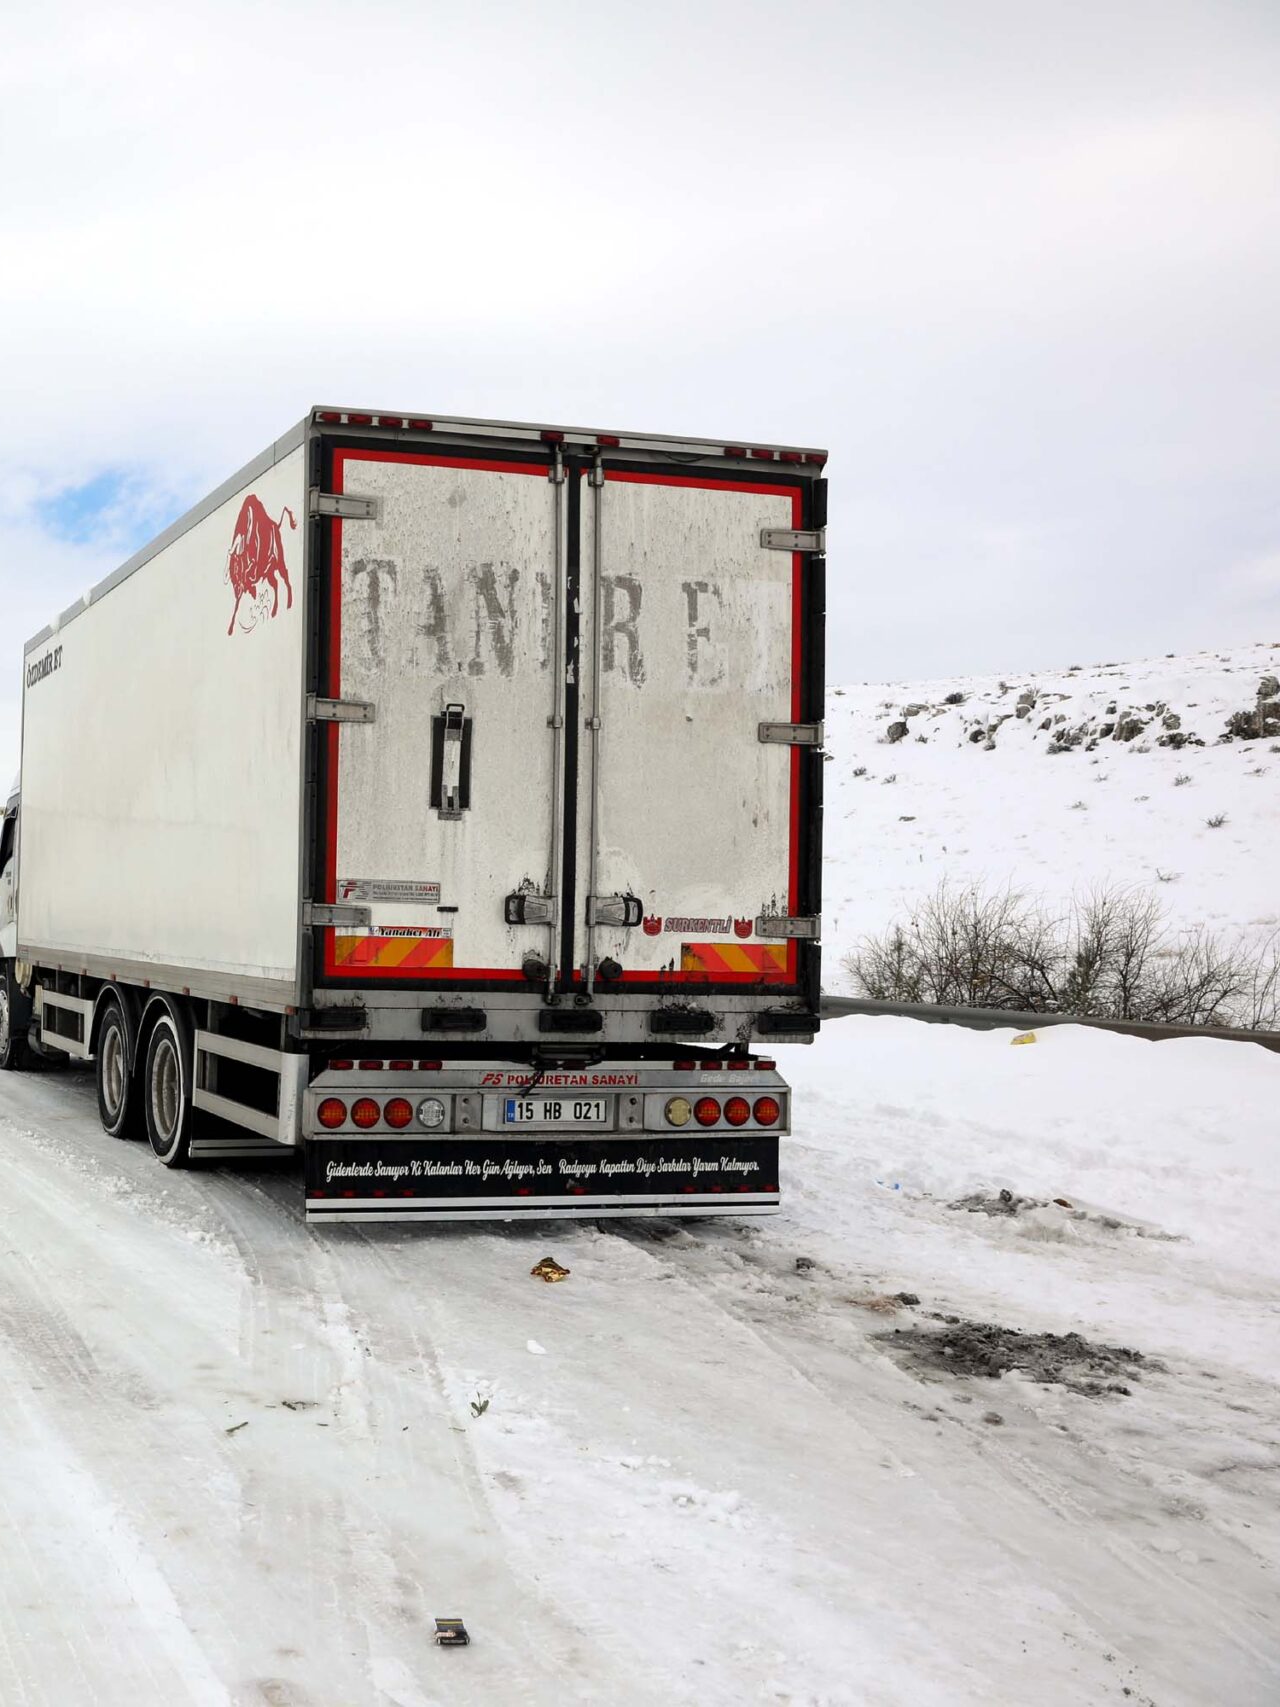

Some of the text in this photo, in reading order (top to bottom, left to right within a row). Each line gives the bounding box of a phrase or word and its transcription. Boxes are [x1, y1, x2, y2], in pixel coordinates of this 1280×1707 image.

[479, 1072, 504, 1085] PS
[591, 1073, 638, 1085] SANAYİ
[517, 1102, 534, 1120] 15
[544, 1102, 562, 1120] HB
[573, 1102, 600, 1120] 021
[326, 1160, 374, 1183] Gidenlerde
[410, 1160, 422, 1176] Ki
[422, 1160, 463, 1176] Kalanlar
[464, 1159, 481, 1175] Her
[482, 1159, 501, 1181] Gün
[536, 1158, 553, 1175] Sen
[558, 1158, 598, 1178] Radyoyu
[636, 1157, 657, 1178] Diye
